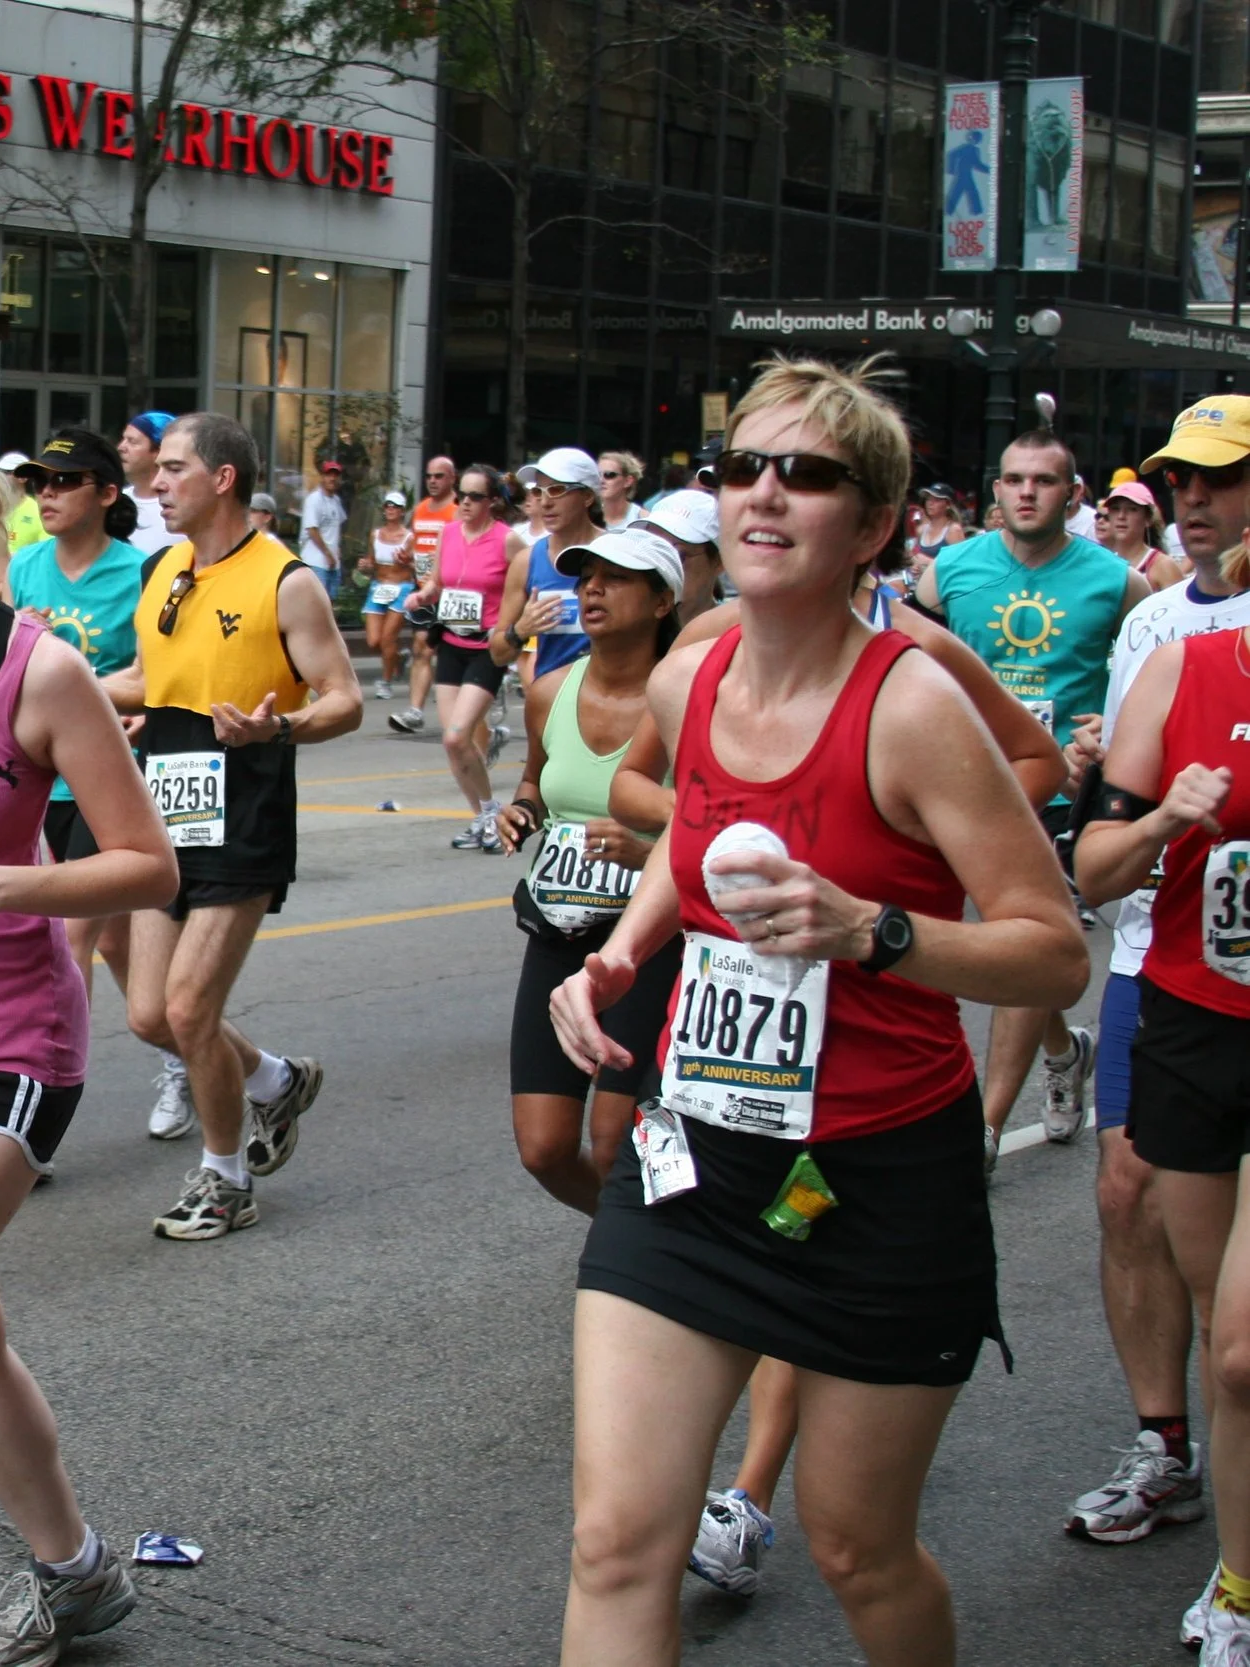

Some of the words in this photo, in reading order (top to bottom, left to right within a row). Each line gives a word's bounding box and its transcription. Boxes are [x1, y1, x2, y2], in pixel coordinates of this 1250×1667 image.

[953, 92, 986, 105] FREE
[950, 104, 989, 117] AUDIO
[1070, 89, 1083, 141] LOOP
[949, 116, 990, 130] TOURS
[1066, 148, 1084, 254] LANDMARK
[947, 221, 984, 234] LOOP
[955, 232, 979, 244] THE
[947, 245, 984, 257] LOOP
[730, 309, 869, 333] Amalgamated
[875, 310, 926, 330] Bank
[1130, 320, 1190, 347] Amalgamated
[1192, 329, 1214, 350] Bank
[441, 601, 478, 621] 37456
[150, 775, 218, 812] 25259
[536, 844, 634, 897] 20810
[711, 954, 754, 976] LaSalle
[676, 978, 808, 1069] 10879
[702, 1064, 803, 1087] ANNIVERSARY
